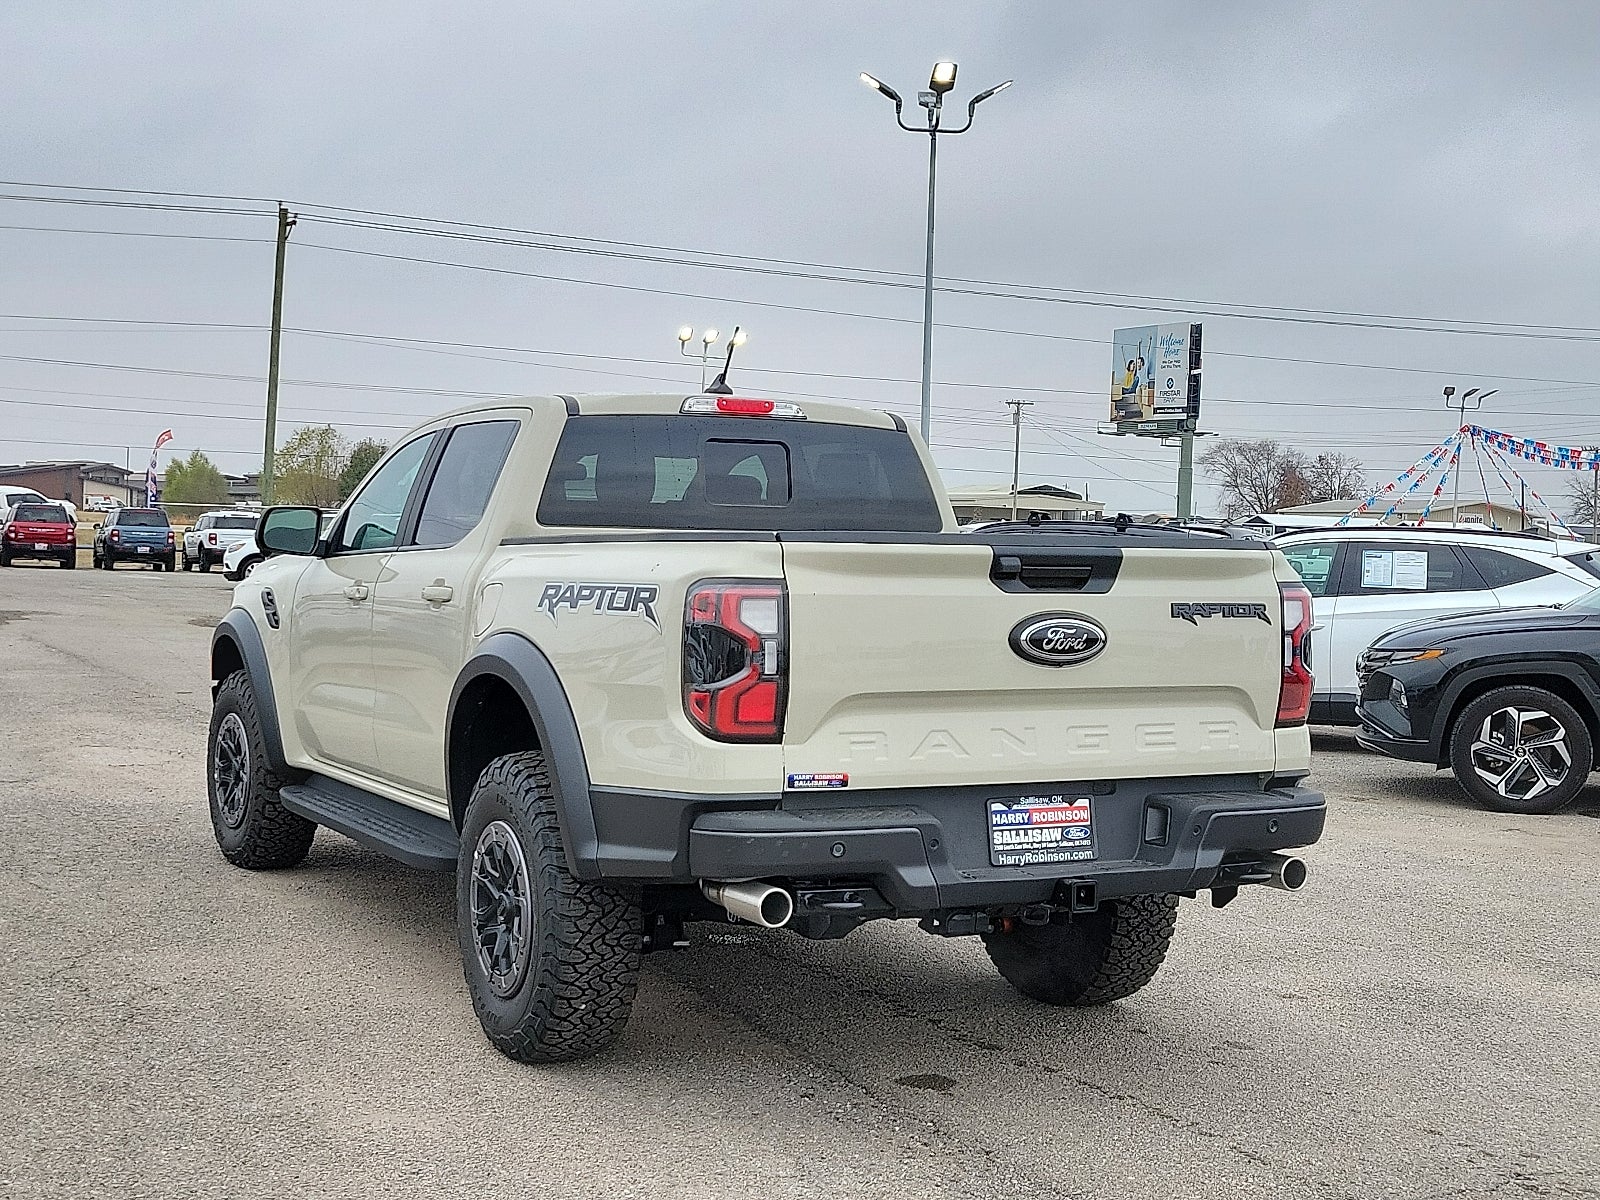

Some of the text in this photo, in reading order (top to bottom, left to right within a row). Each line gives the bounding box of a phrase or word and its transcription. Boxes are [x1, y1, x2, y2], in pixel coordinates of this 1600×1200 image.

[535, 581, 662, 635] RAPTOR
[1171, 602, 1272, 626] RAPTOR
[1042, 627, 1088, 650] Ford
[838, 720, 1239, 762] RANGER
[1020, 795, 1063, 805] Sallisaw, OK
[992, 809, 1088, 825] HARRY ROBINSON
[993, 828, 1062, 845] SALLISAW
[998, 850, 1093, 866] HarryRobinson.com
